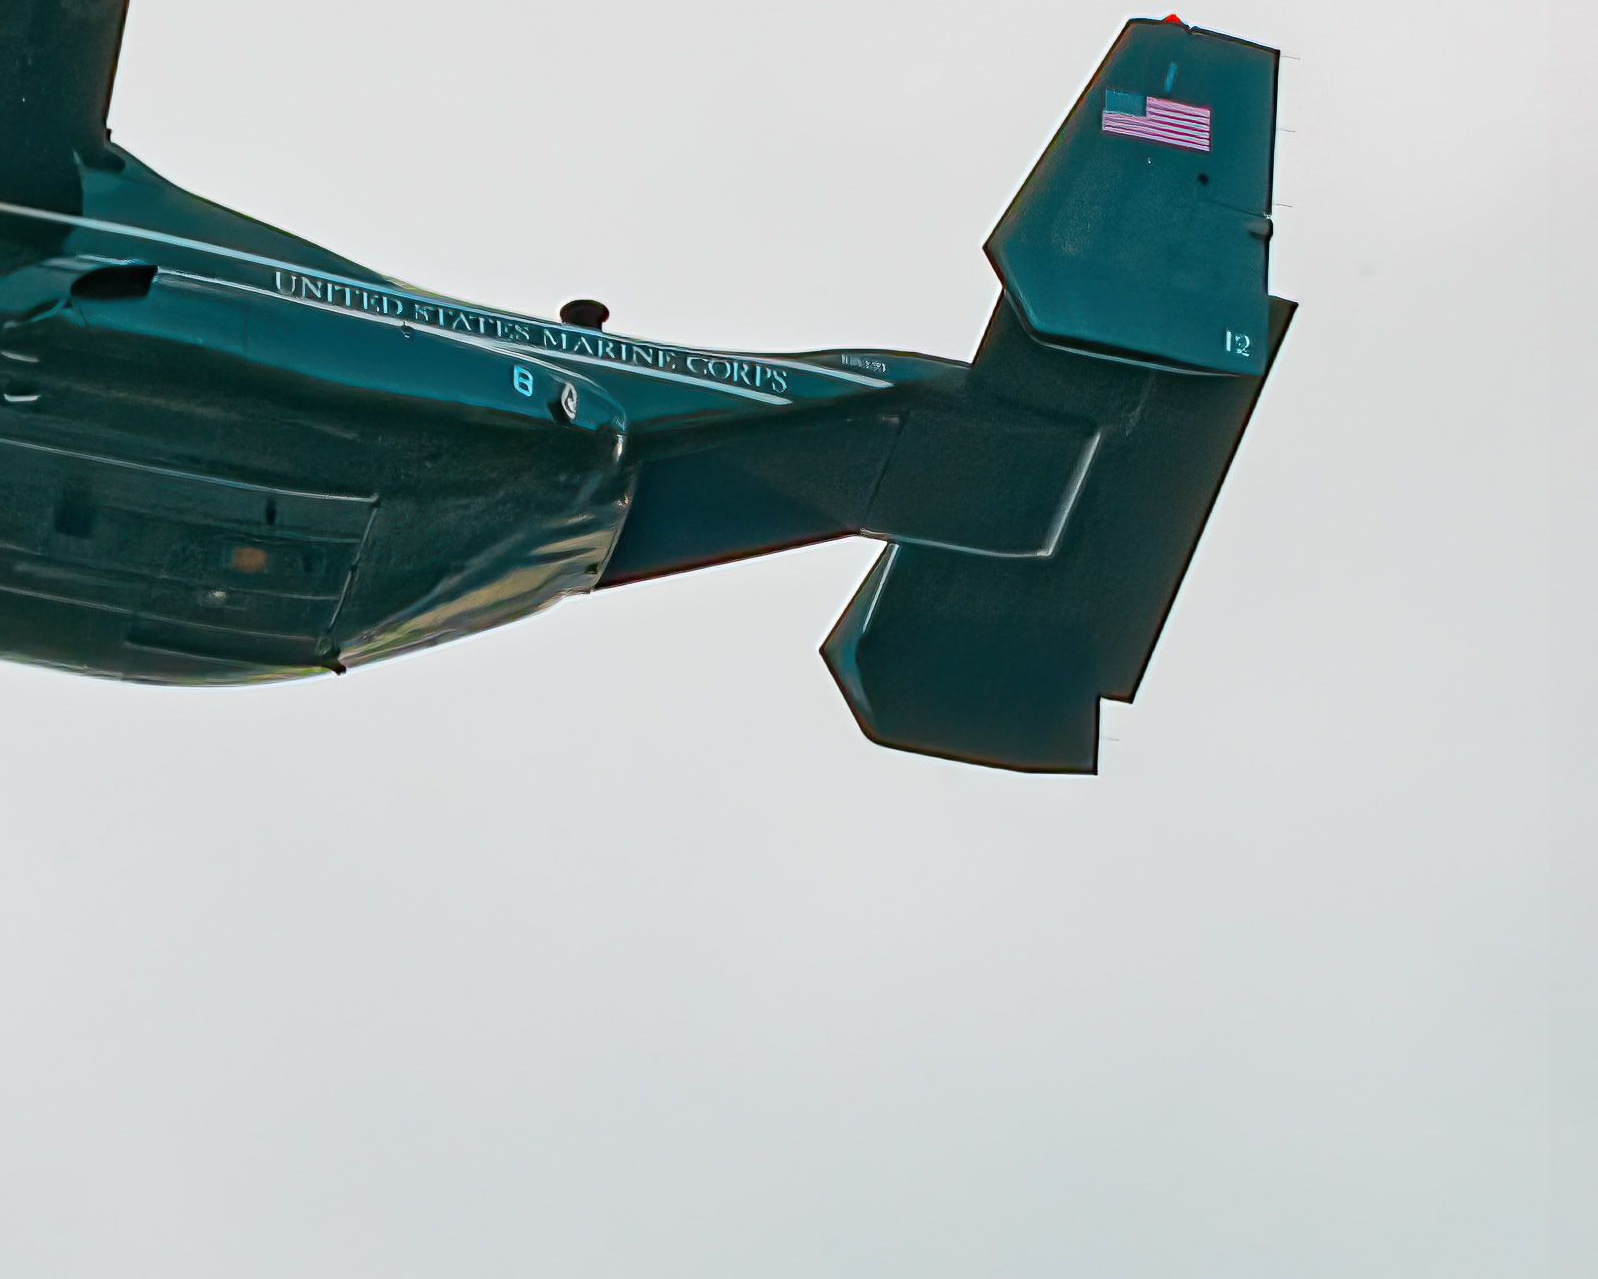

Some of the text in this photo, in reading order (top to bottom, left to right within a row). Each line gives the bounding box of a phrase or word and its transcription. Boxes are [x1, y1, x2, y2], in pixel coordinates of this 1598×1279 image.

[275, 271, 788, 393] UNITED STATES MARINE CORPS
[1226, 330, 1250, 357] 12
